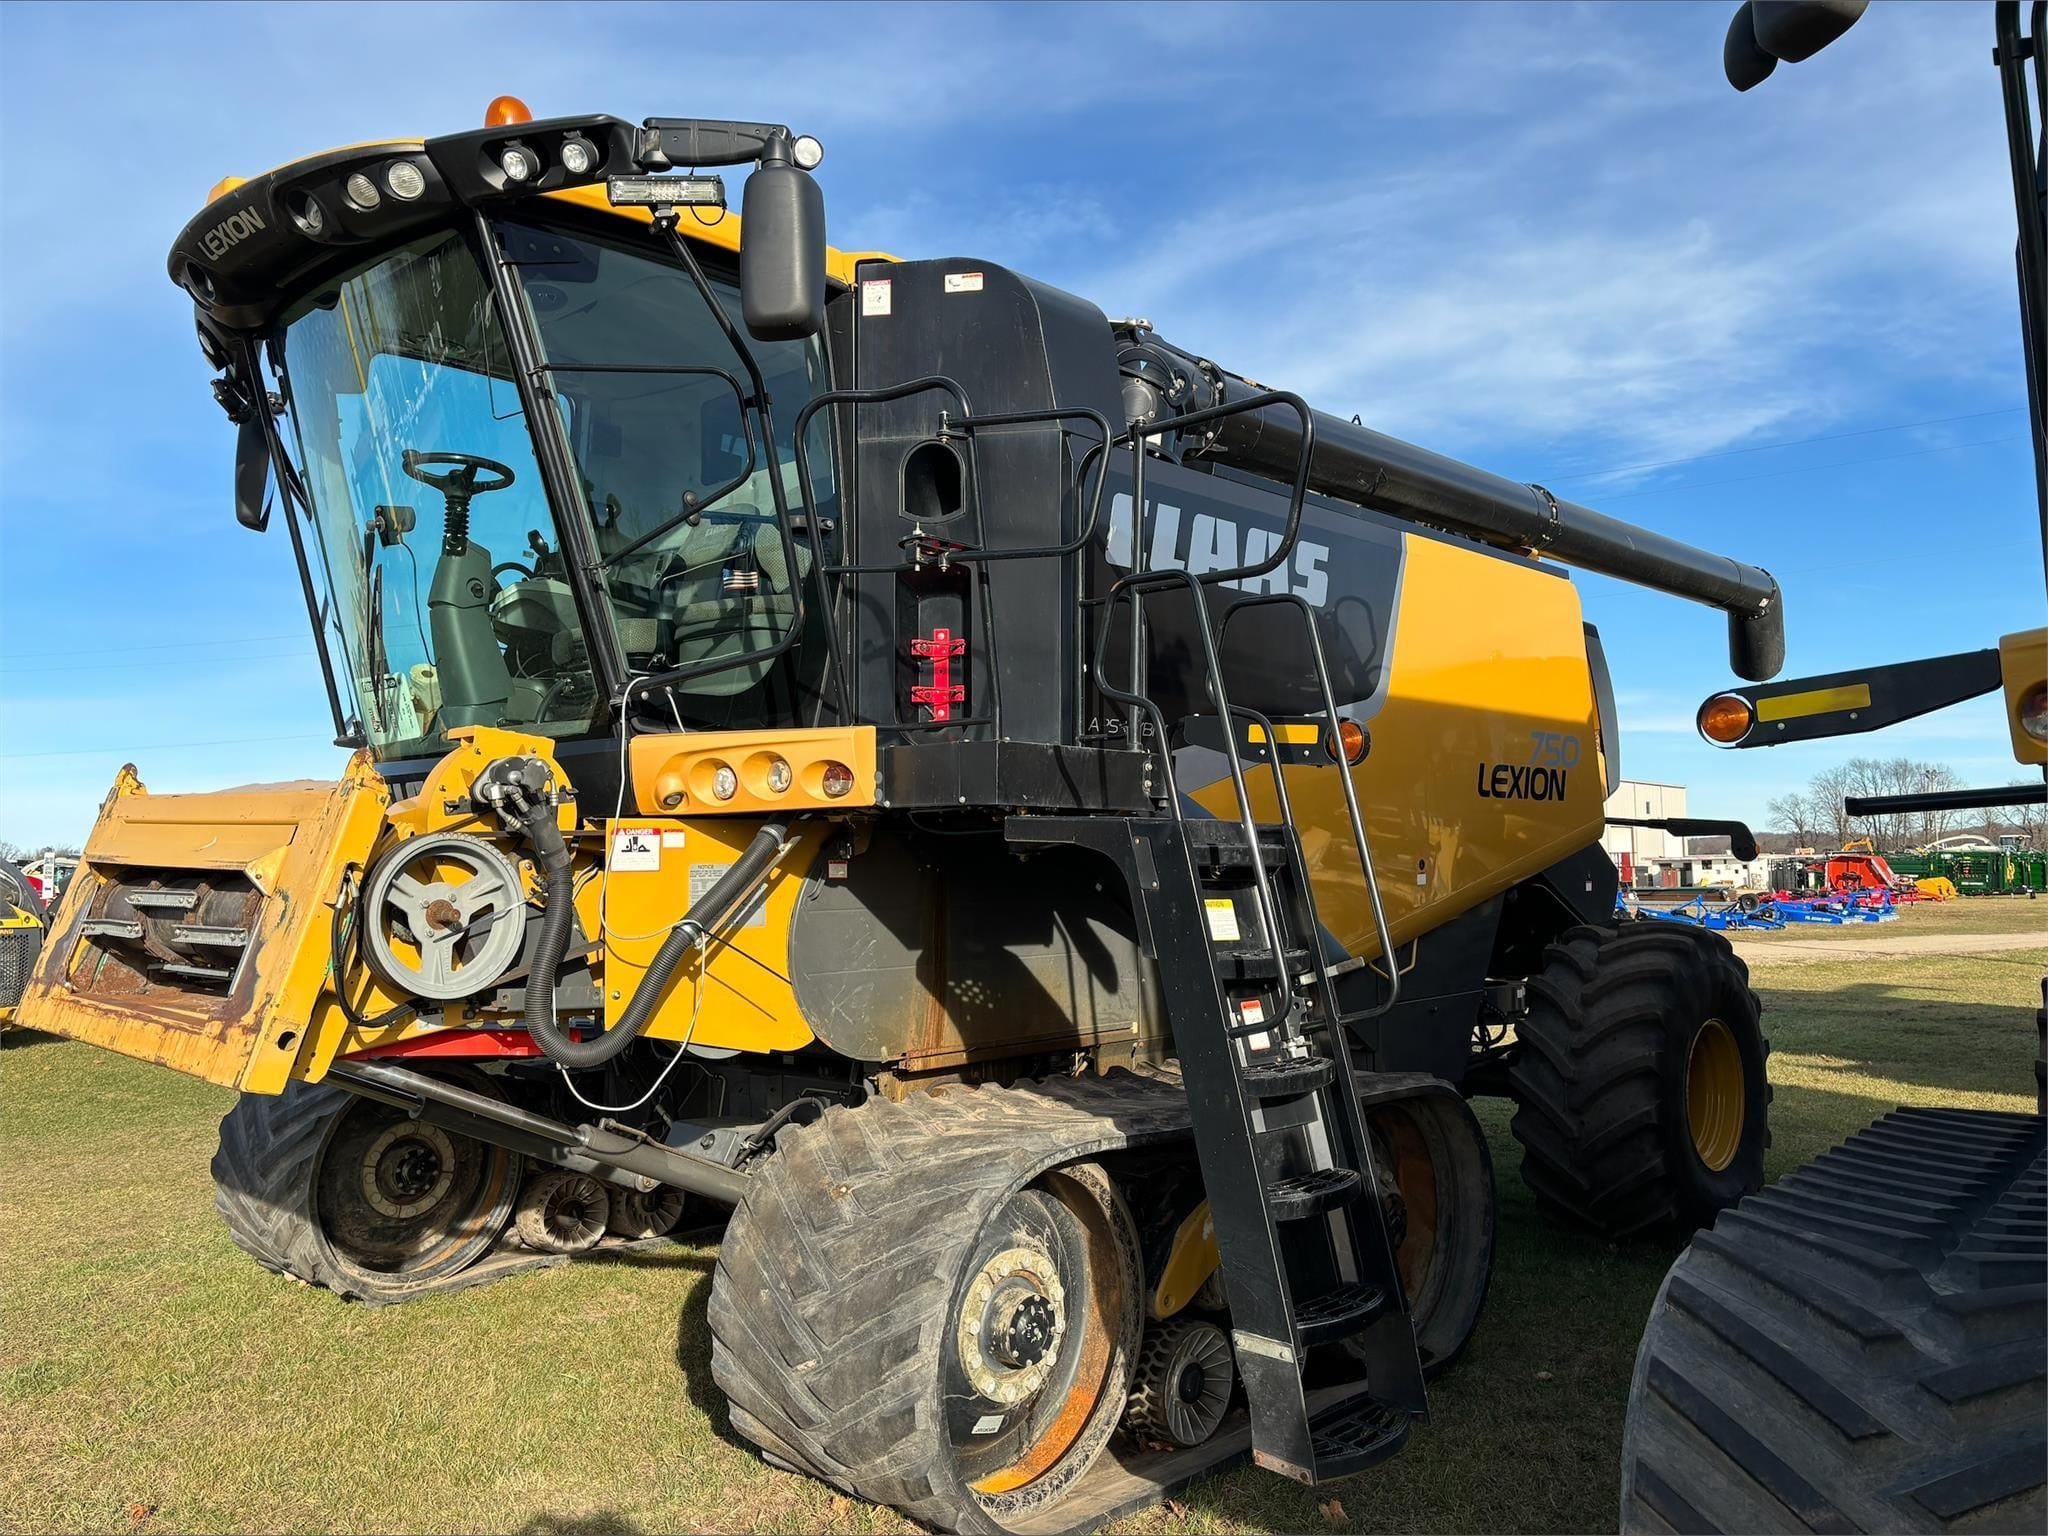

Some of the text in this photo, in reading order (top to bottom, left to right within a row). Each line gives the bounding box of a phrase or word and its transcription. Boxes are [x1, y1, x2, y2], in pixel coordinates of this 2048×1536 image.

[197, 206, 266, 261] LEXION
[1105, 492, 1330, 608] CLAAS
[1529, 730, 1581, 768] 750
[1477, 763, 1567, 802] LEXION
